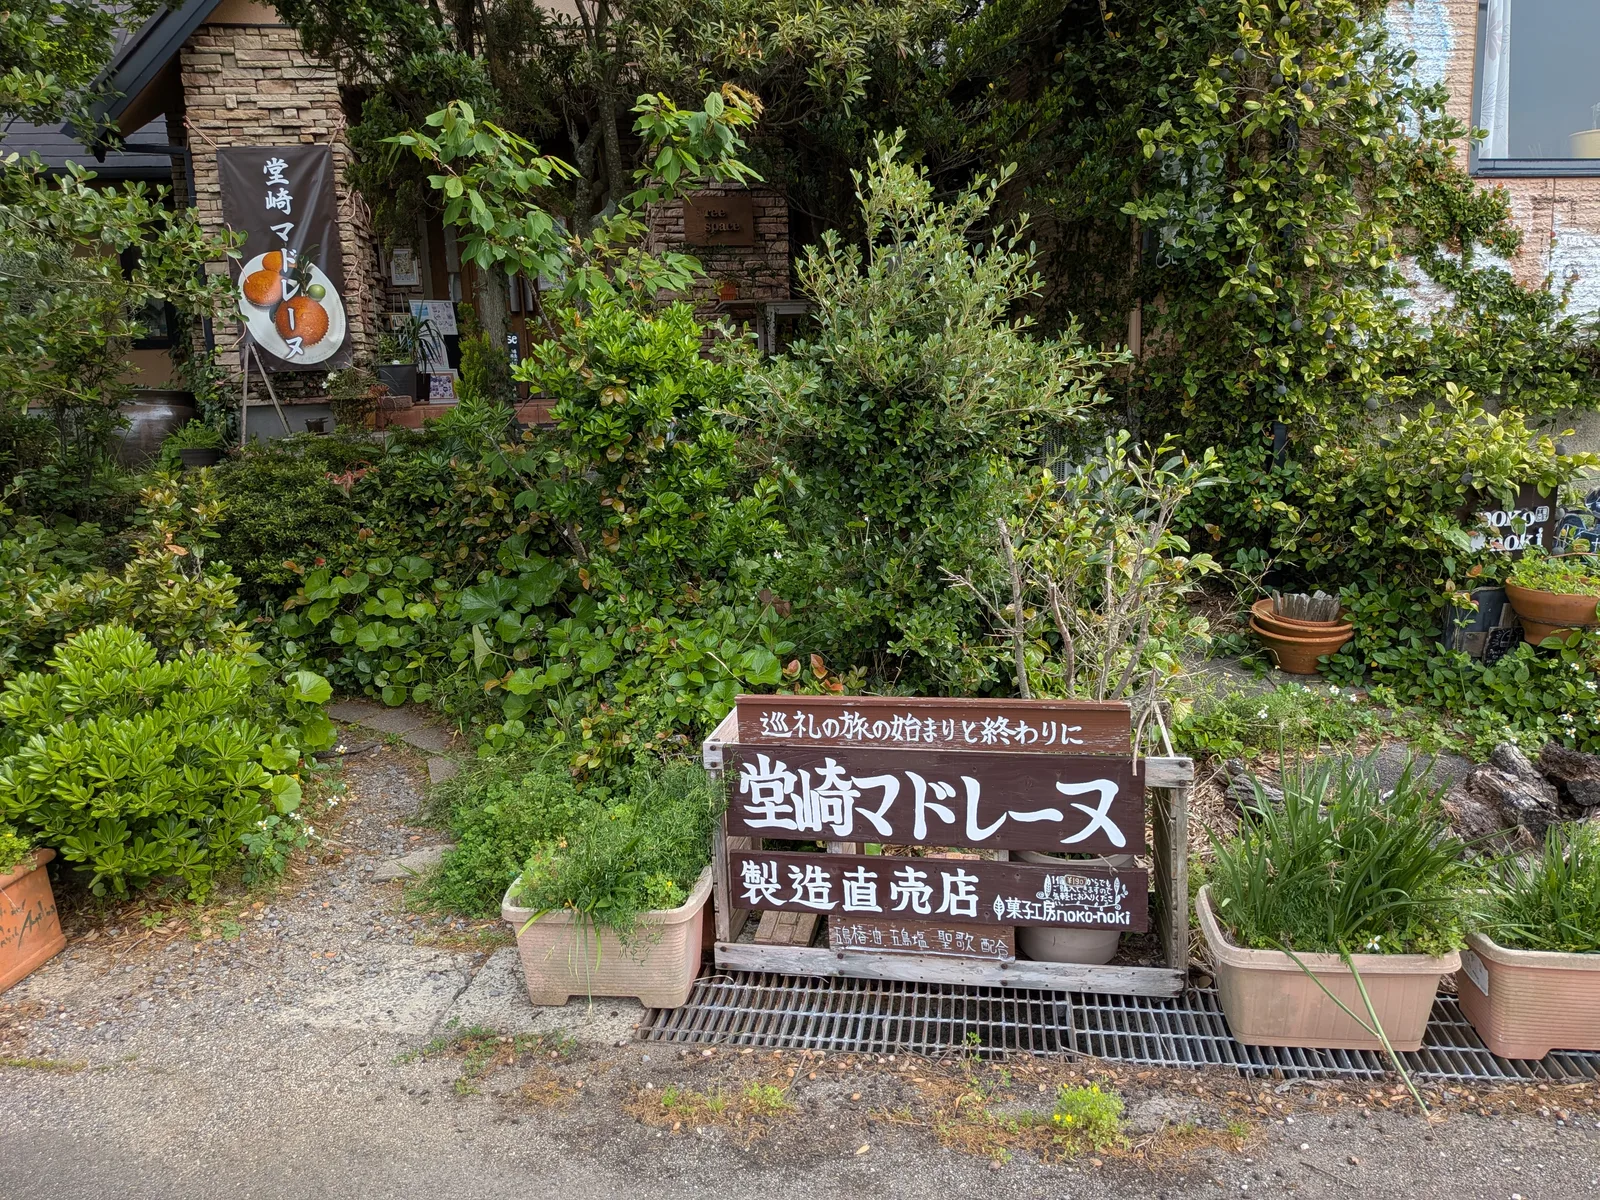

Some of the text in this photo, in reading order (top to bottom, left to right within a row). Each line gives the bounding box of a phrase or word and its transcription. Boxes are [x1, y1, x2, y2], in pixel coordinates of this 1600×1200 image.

[703, 222, 740, 233] space
[262, 156, 305, 360] 堂崎マドレーヌ
[761, 711, 1083, 746] 巡礼の旅の始まりと終わりに
[740, 753, 1127, 847] 堂崎マドレーヌ
[740, 860, 980, 918] 製造直売店
